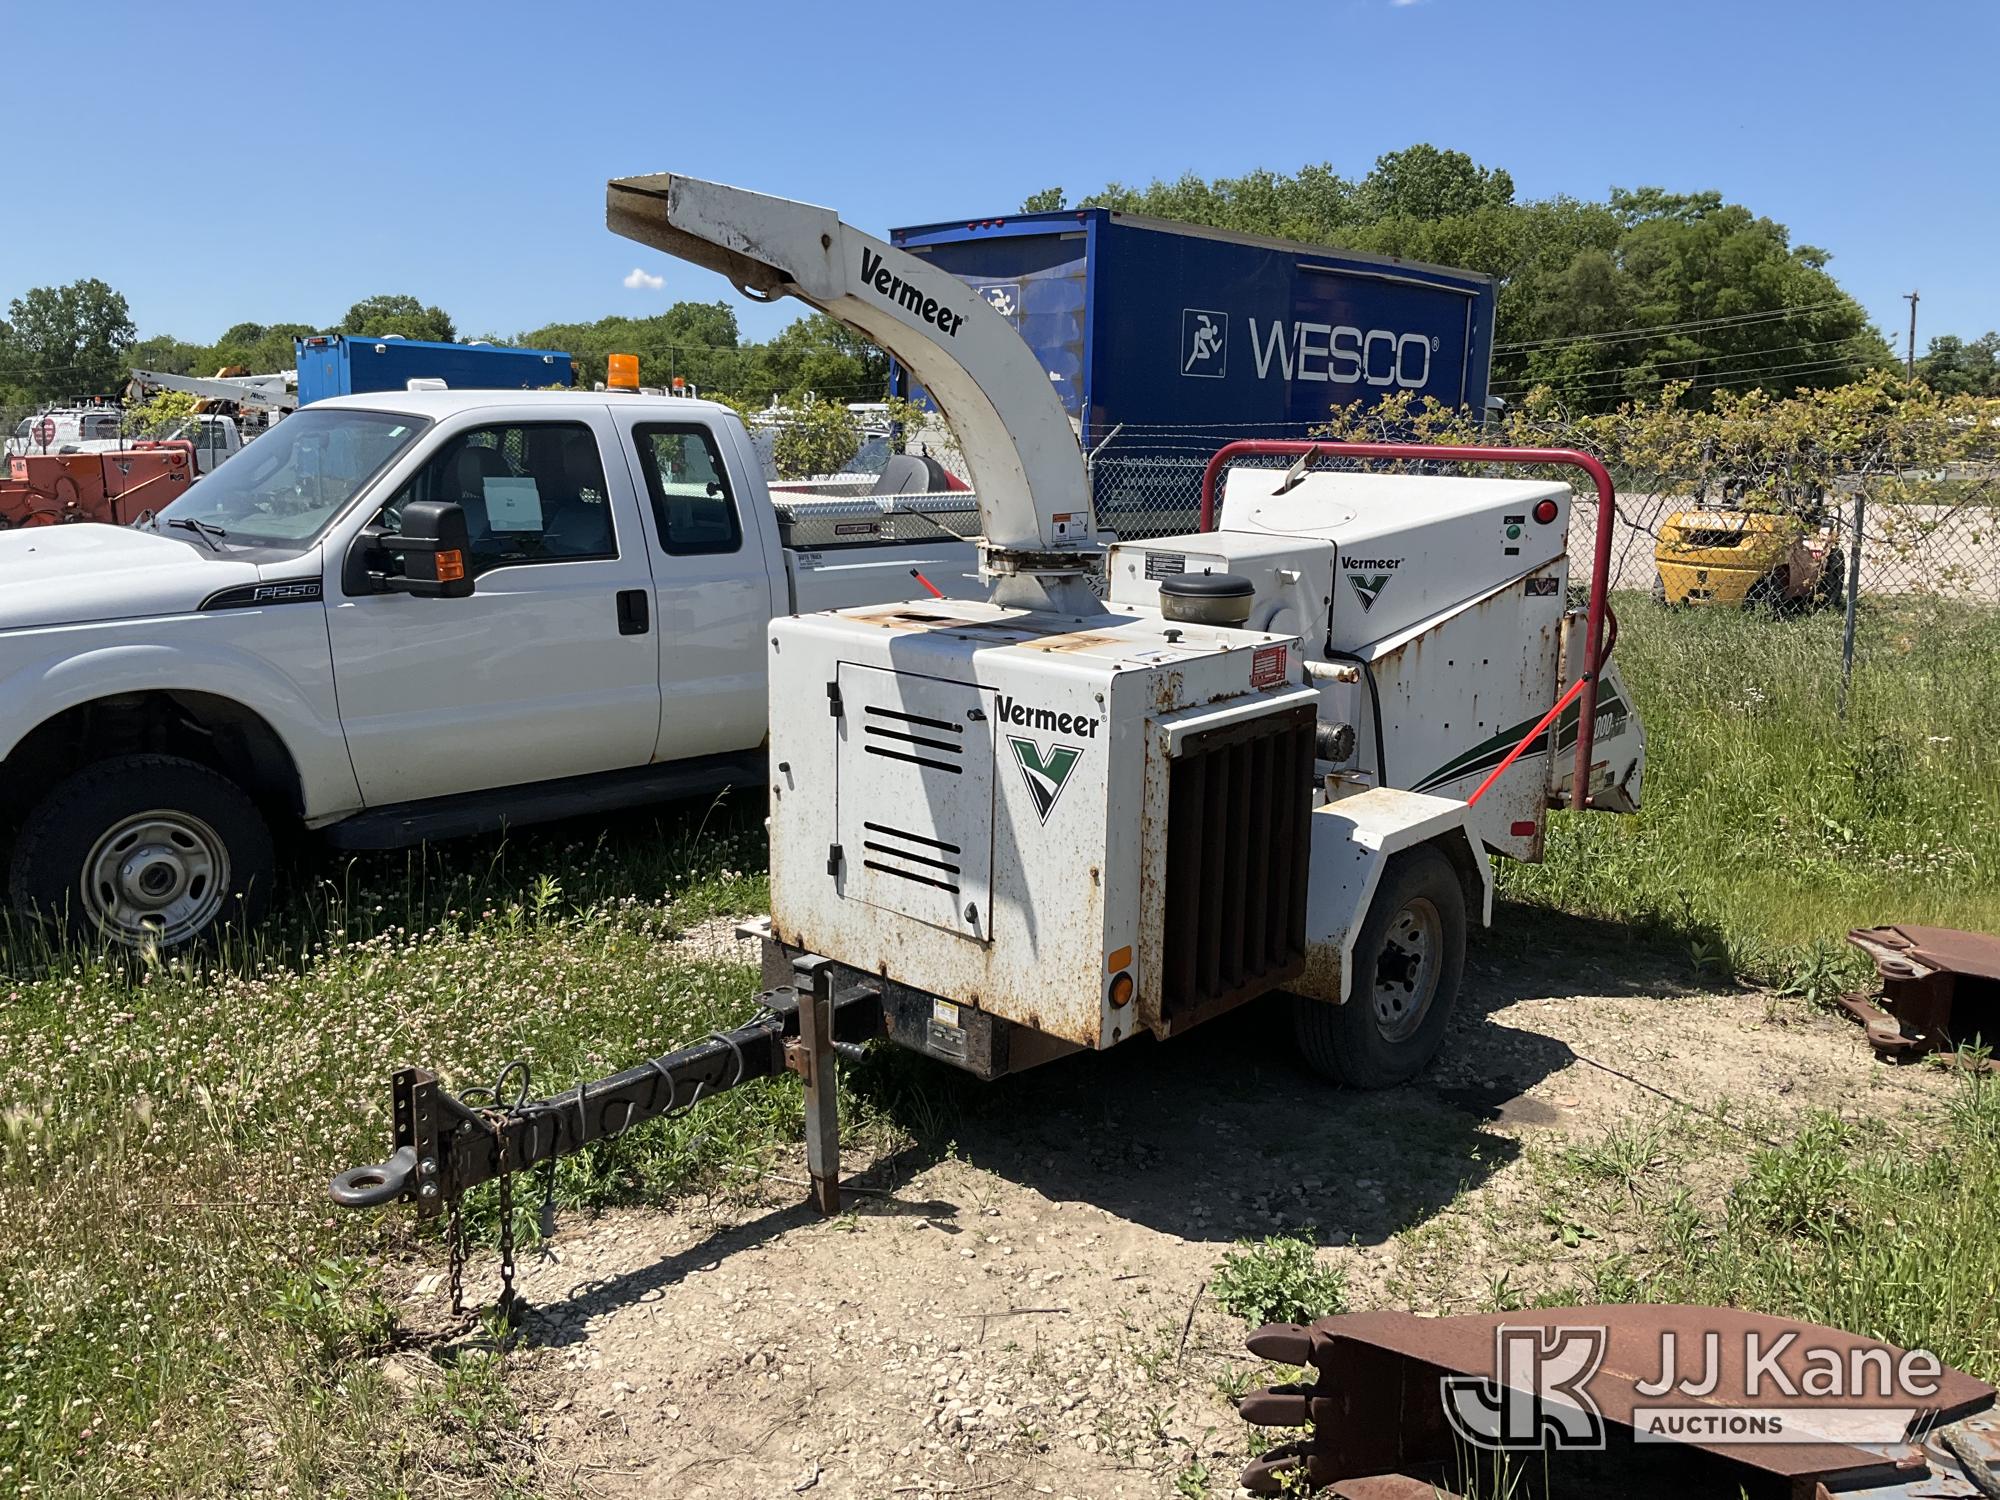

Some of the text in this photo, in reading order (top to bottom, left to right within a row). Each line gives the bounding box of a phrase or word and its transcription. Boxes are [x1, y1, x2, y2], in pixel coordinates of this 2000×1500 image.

[860, 246, 963, 338] Vermeer
[1248, 317, 1431, 389] WESCO
[1341, 556, 1400, 569] Vermeer
[997, 695, 1099, 739] Vermeer
